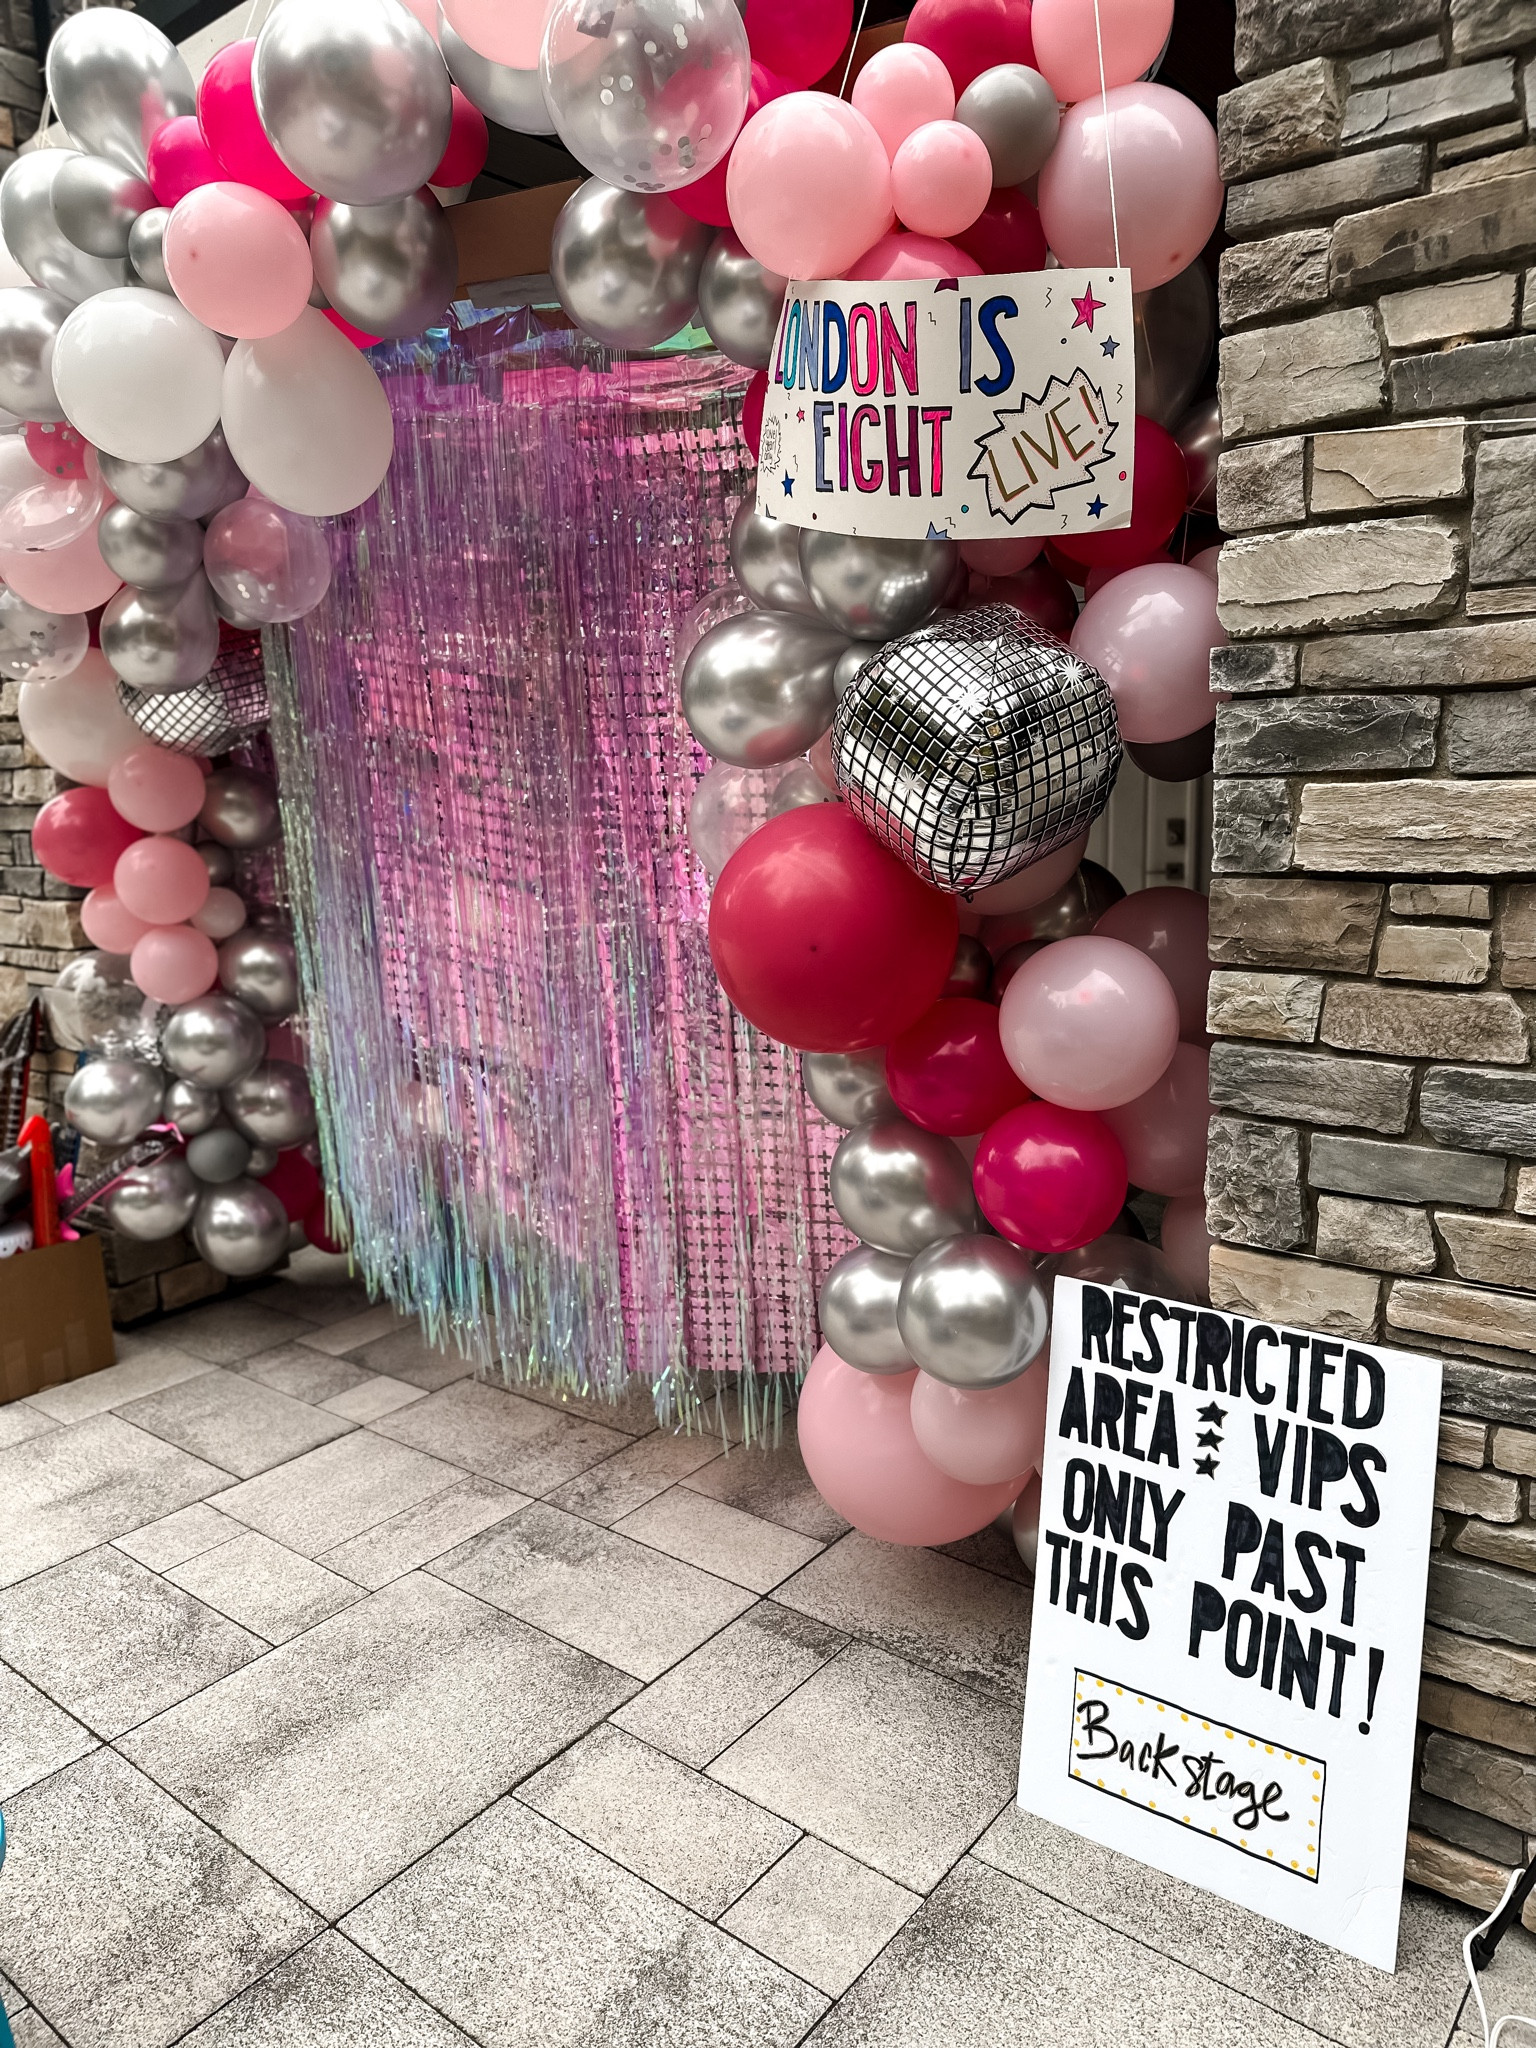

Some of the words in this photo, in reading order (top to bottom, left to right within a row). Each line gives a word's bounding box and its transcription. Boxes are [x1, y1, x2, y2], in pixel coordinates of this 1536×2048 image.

[774, 299, 919, 397] LONDON
[959, 295, 1019, 397] IS
[814, 401, 952, 497] EIGHT
[987, 385, 1105, 503] LIVE!
[1081, 1284, 1386, 1430] RESTRICTED
[1058, 1366, 1180, 1469] AREA
[1254, 1413, 1387, 1528] VIPS
[1062, 1457, 1186, 1562] ONLY
[1221, 1501, 1366, 1627] PAST
[1045, 1529, 1153, 1641] THIS
[1188, 1580, 1385, 1736] POINT!
[1076, 1699, 1290, 1831] Backstage
